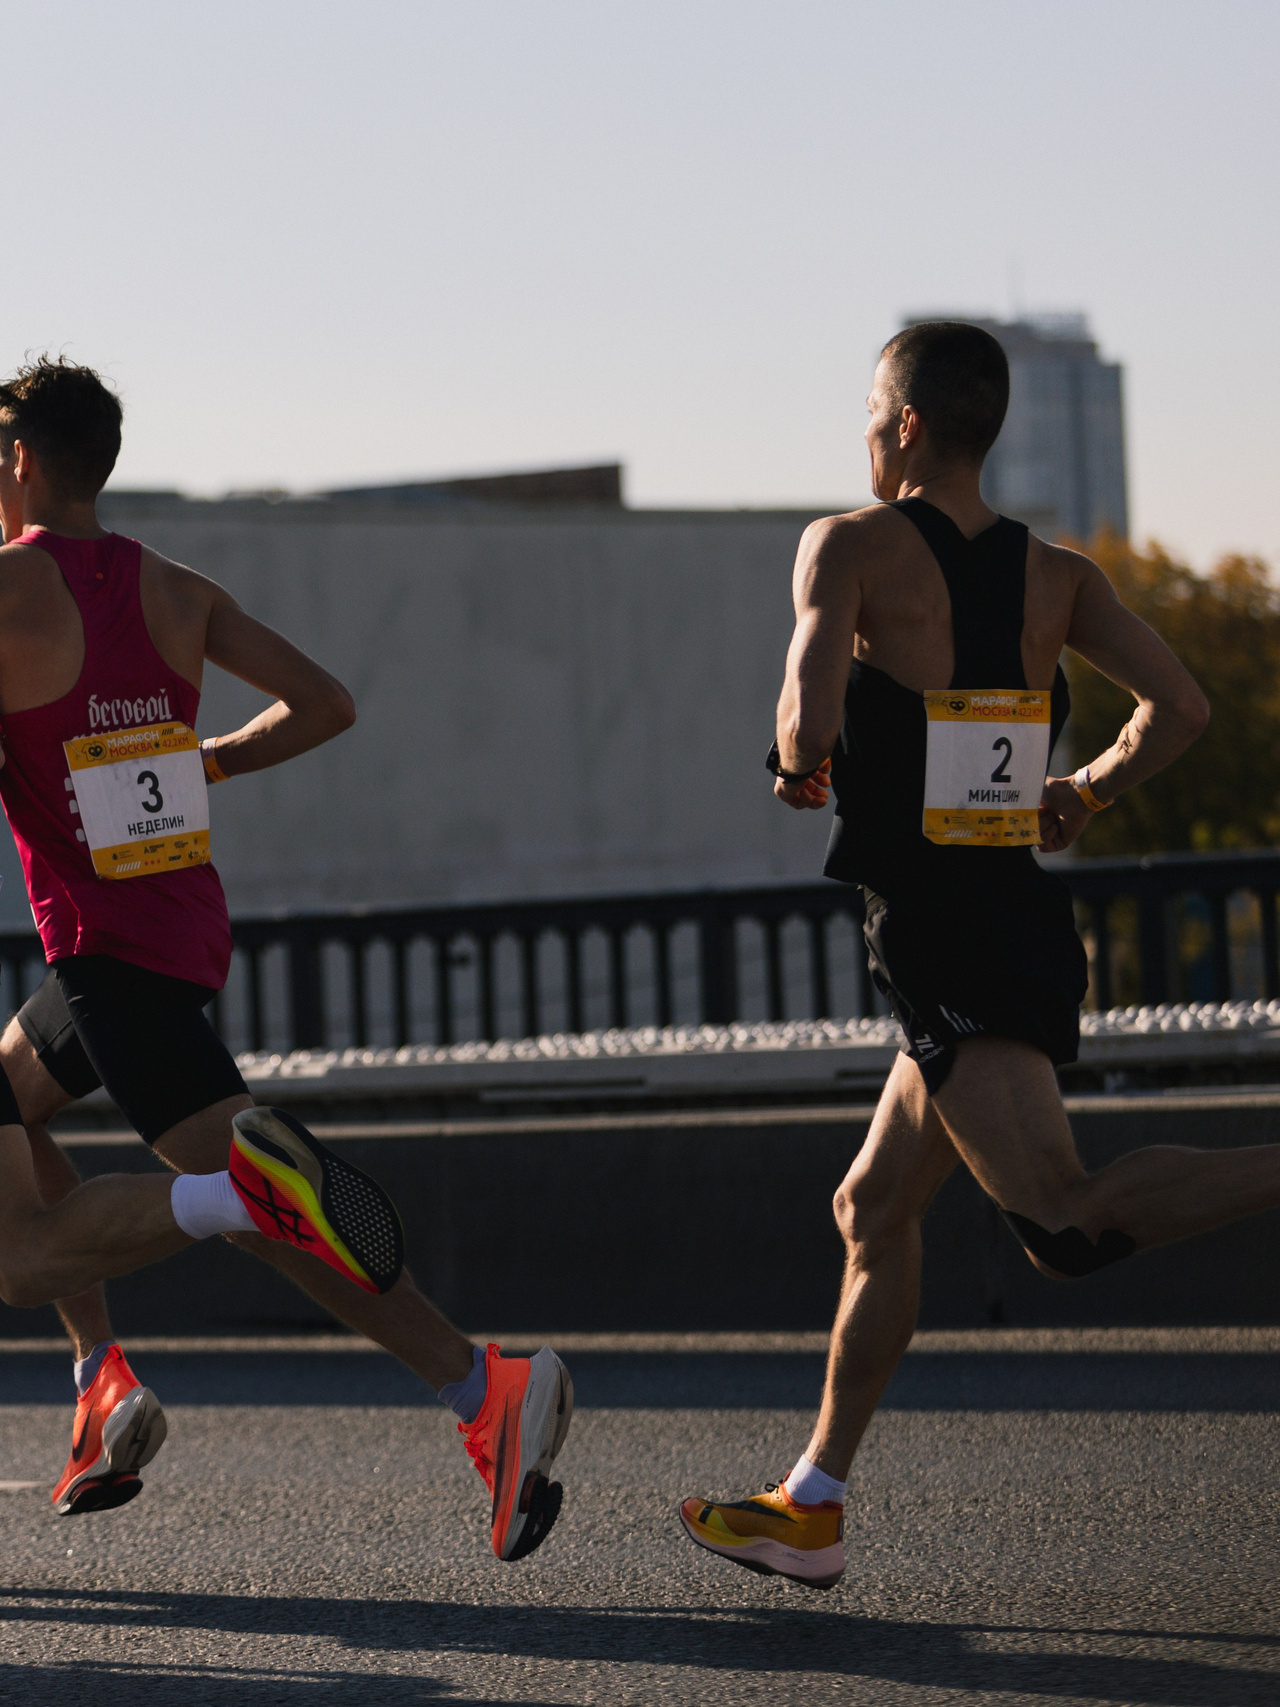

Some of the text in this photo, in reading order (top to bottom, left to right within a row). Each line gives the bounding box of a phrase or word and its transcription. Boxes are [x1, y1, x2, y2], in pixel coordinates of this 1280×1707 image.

[88, 688, 173, 728] беговой
[106, 730, 160, 749] МАРАФОН
[109, 742, 153, 758] МОСКВА
[991, 736, 1013, 783] 2
[137, 770, 164, 813] 3
[968, 789, 1020, 803] МИНШИН
[128, 815, 185, 837] НЕДЕЛИН
